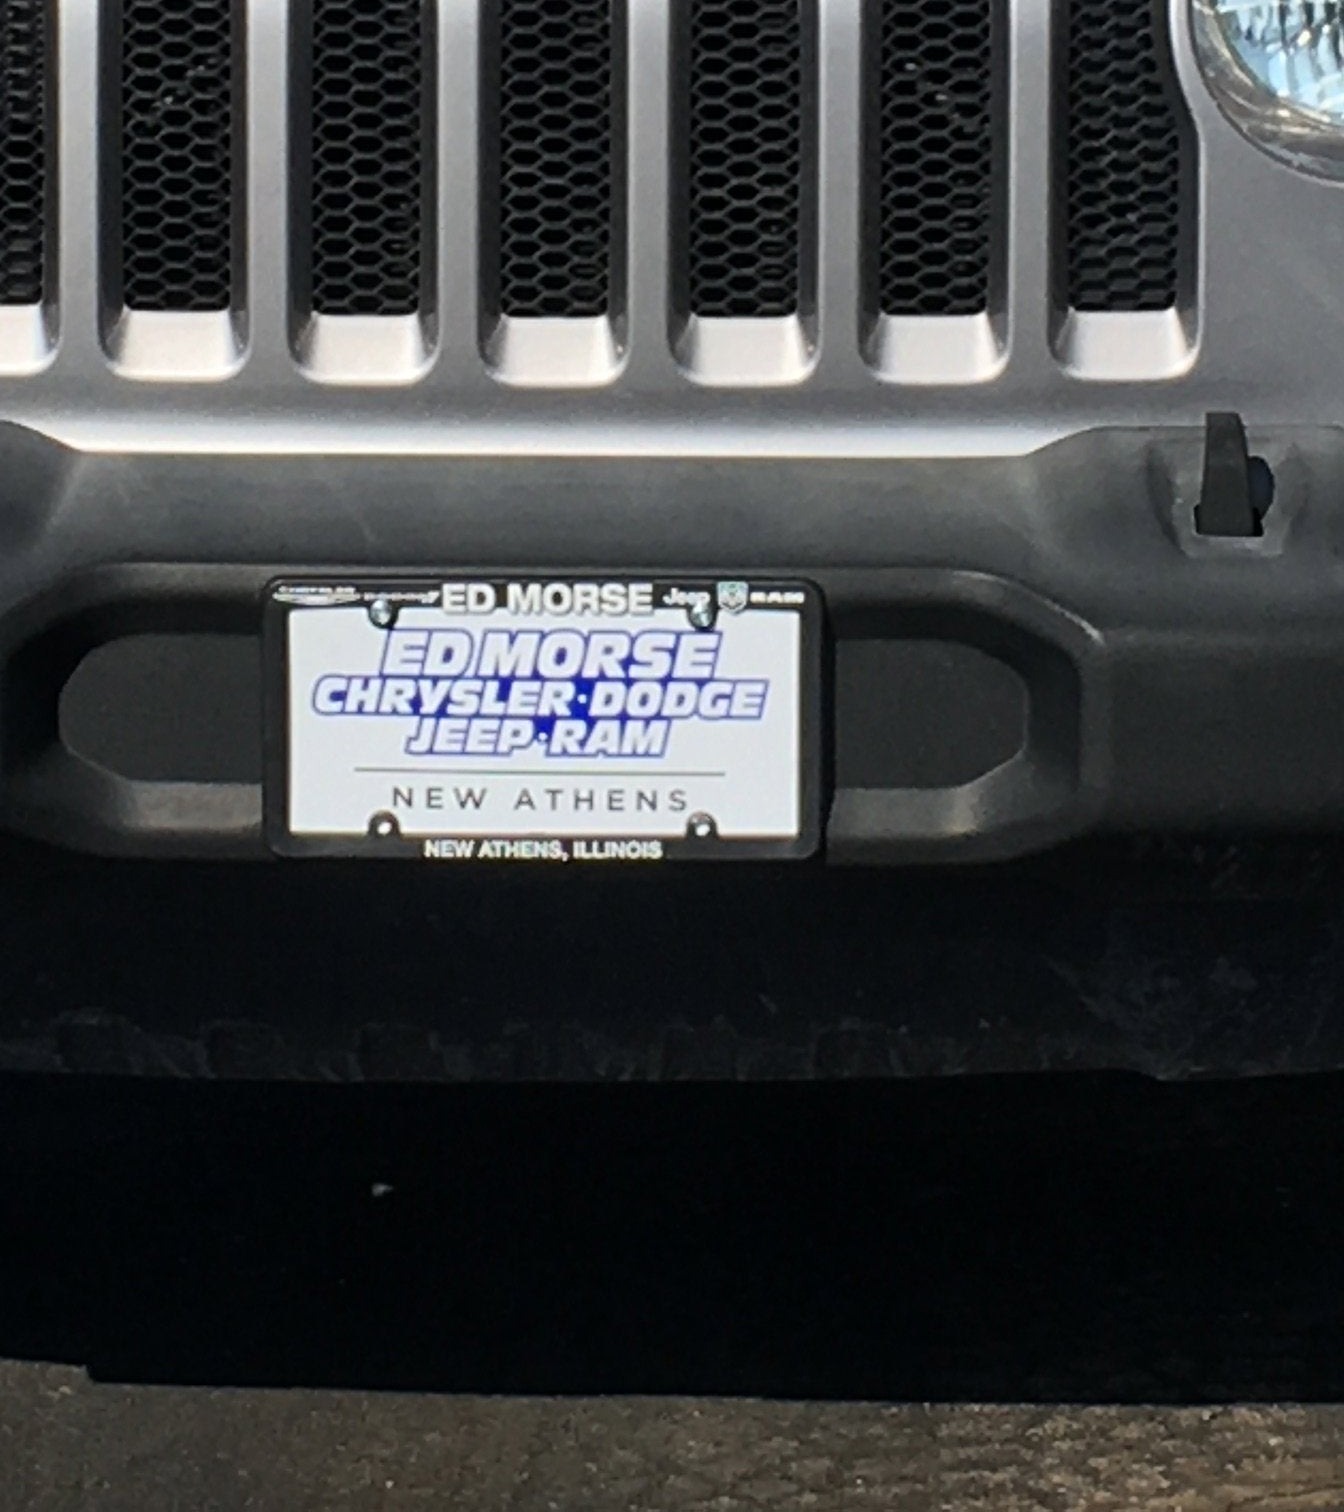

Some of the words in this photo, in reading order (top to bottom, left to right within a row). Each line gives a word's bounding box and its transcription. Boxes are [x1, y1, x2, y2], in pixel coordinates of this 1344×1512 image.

[442, 582, 497, 615] ED
[507, 582, 655, 616] MORSE
[380, 628, 475, 678] ED
[474, 628, 723, 680] MORSE
[313, 674, 576, 718] CHRYSLER
[587, 679, 769, 720] DODGE
[405, 716, 536, 756] JEEP
[545, 718, 672, 758] RAM
[392, 787, 487, 809] NEW
[513, 788, 688, 811] ATHENS
[424, 839, 474, 858] NEW
[476, 839, 570, 861] ATHENS,
[572, 840, 663, 859] ILLINOIS
